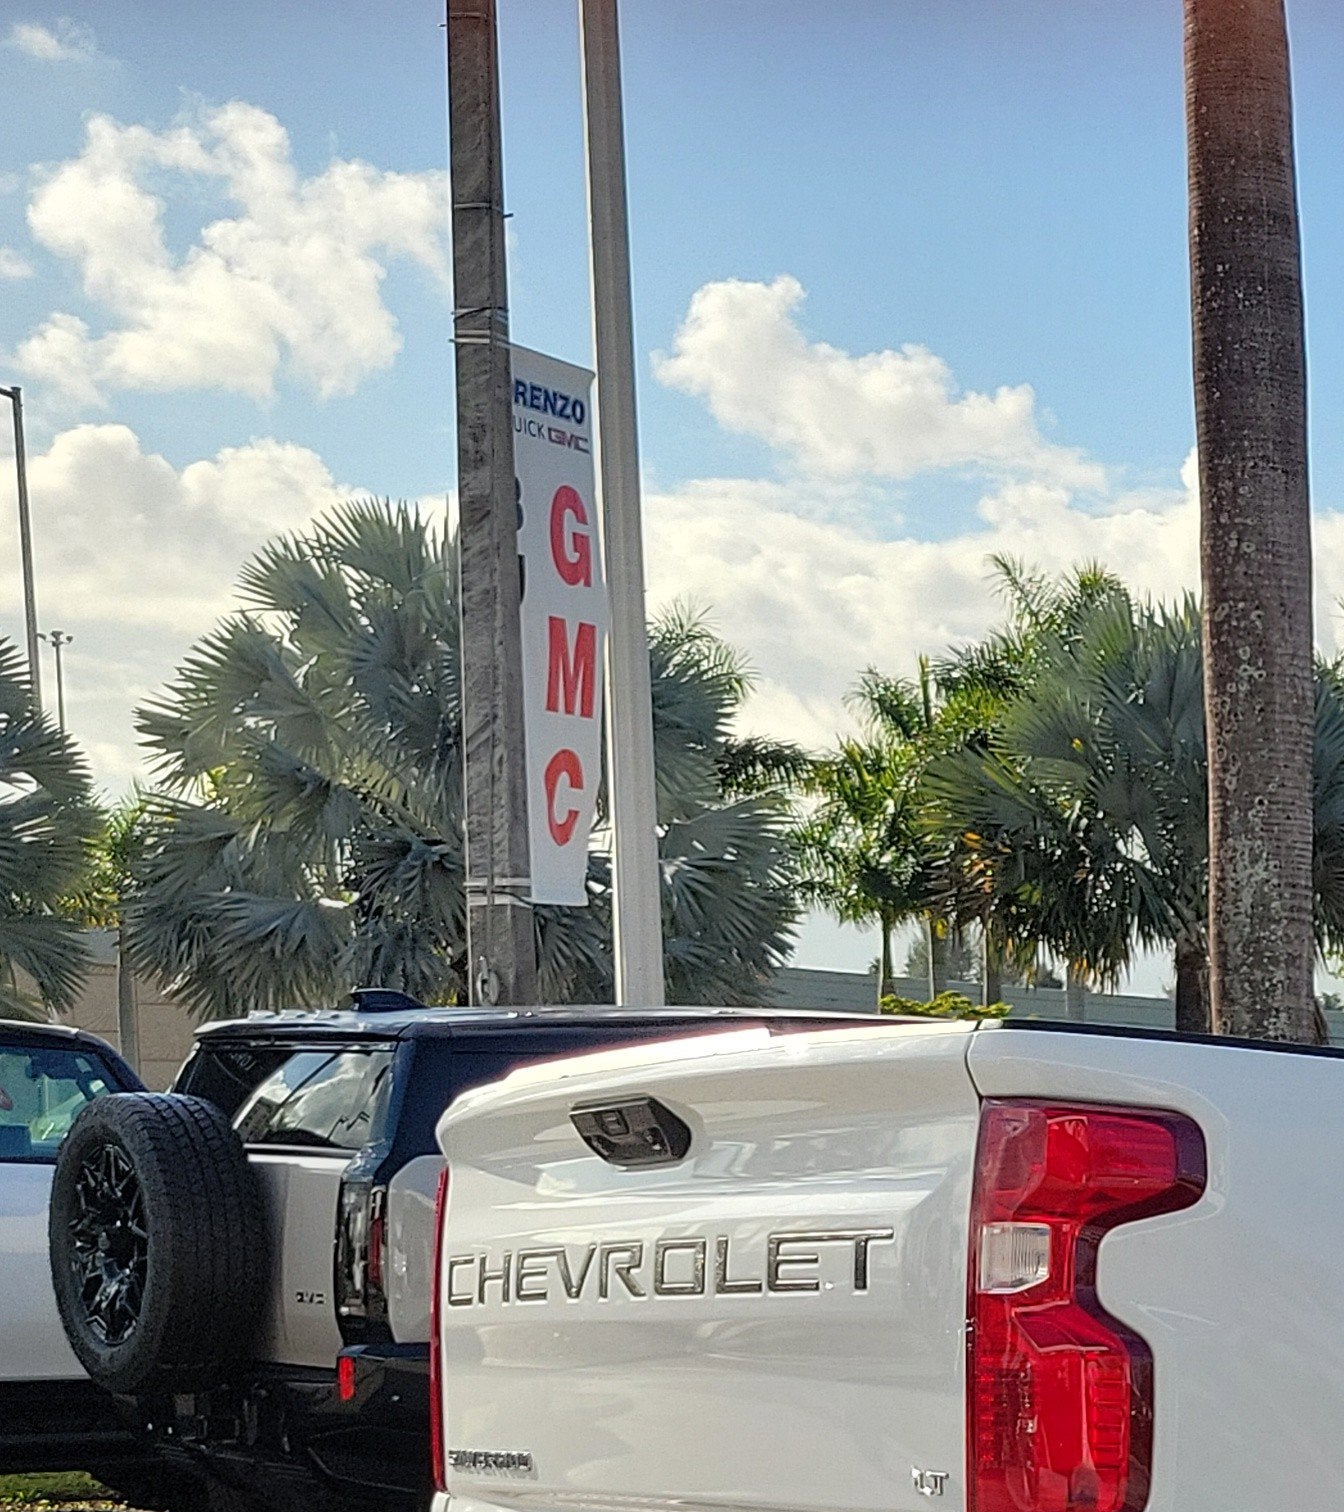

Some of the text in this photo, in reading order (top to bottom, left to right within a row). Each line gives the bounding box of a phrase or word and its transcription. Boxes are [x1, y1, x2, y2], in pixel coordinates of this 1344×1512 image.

[514, 379, 585, 424] RENZO
[545, 485, 597, 847] GMC
[447, 1227, 895, 1306] CHEVROLET
[911, 1468, 950, 1497] LT
